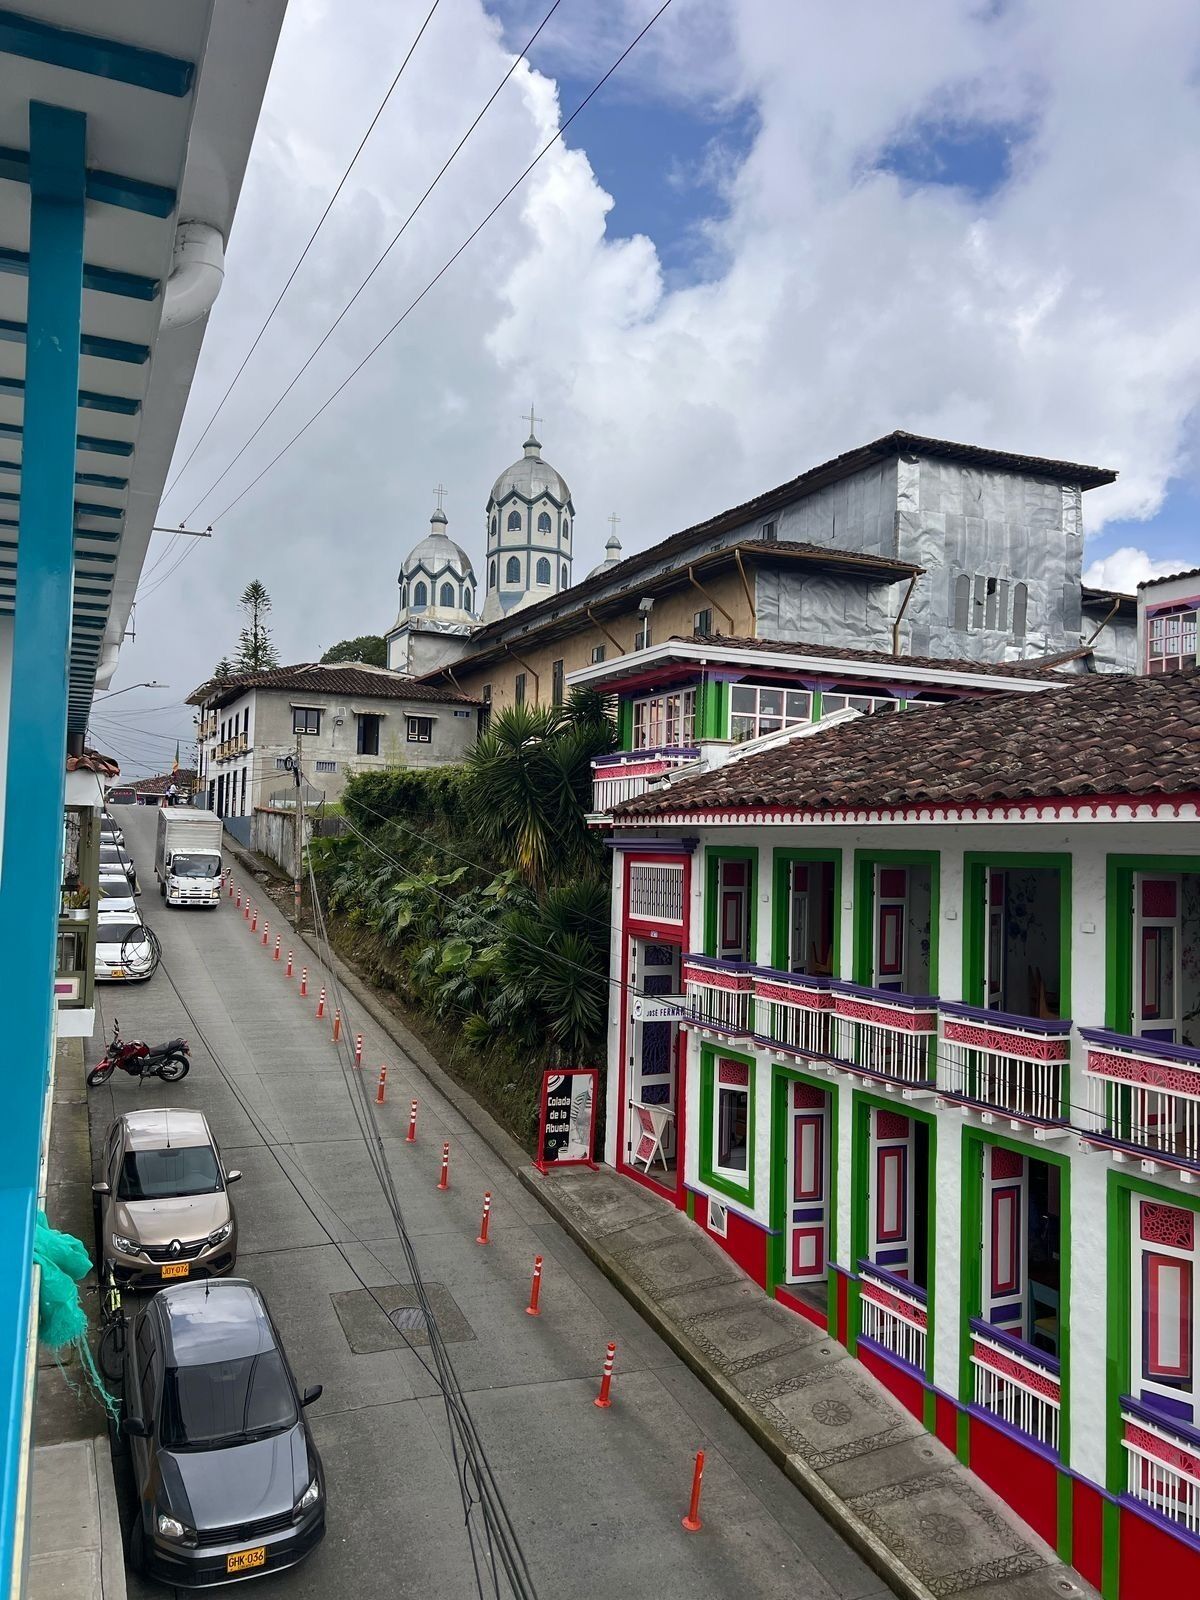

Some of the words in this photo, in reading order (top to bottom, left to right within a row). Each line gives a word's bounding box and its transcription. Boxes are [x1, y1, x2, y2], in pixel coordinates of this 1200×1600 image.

[547, 1096, 571, 1107] Colada
[549, 1109, 559, 1120] de
[560, 1109, 567, 1119] la
[545, 1122, 570, 1133] Abuela
